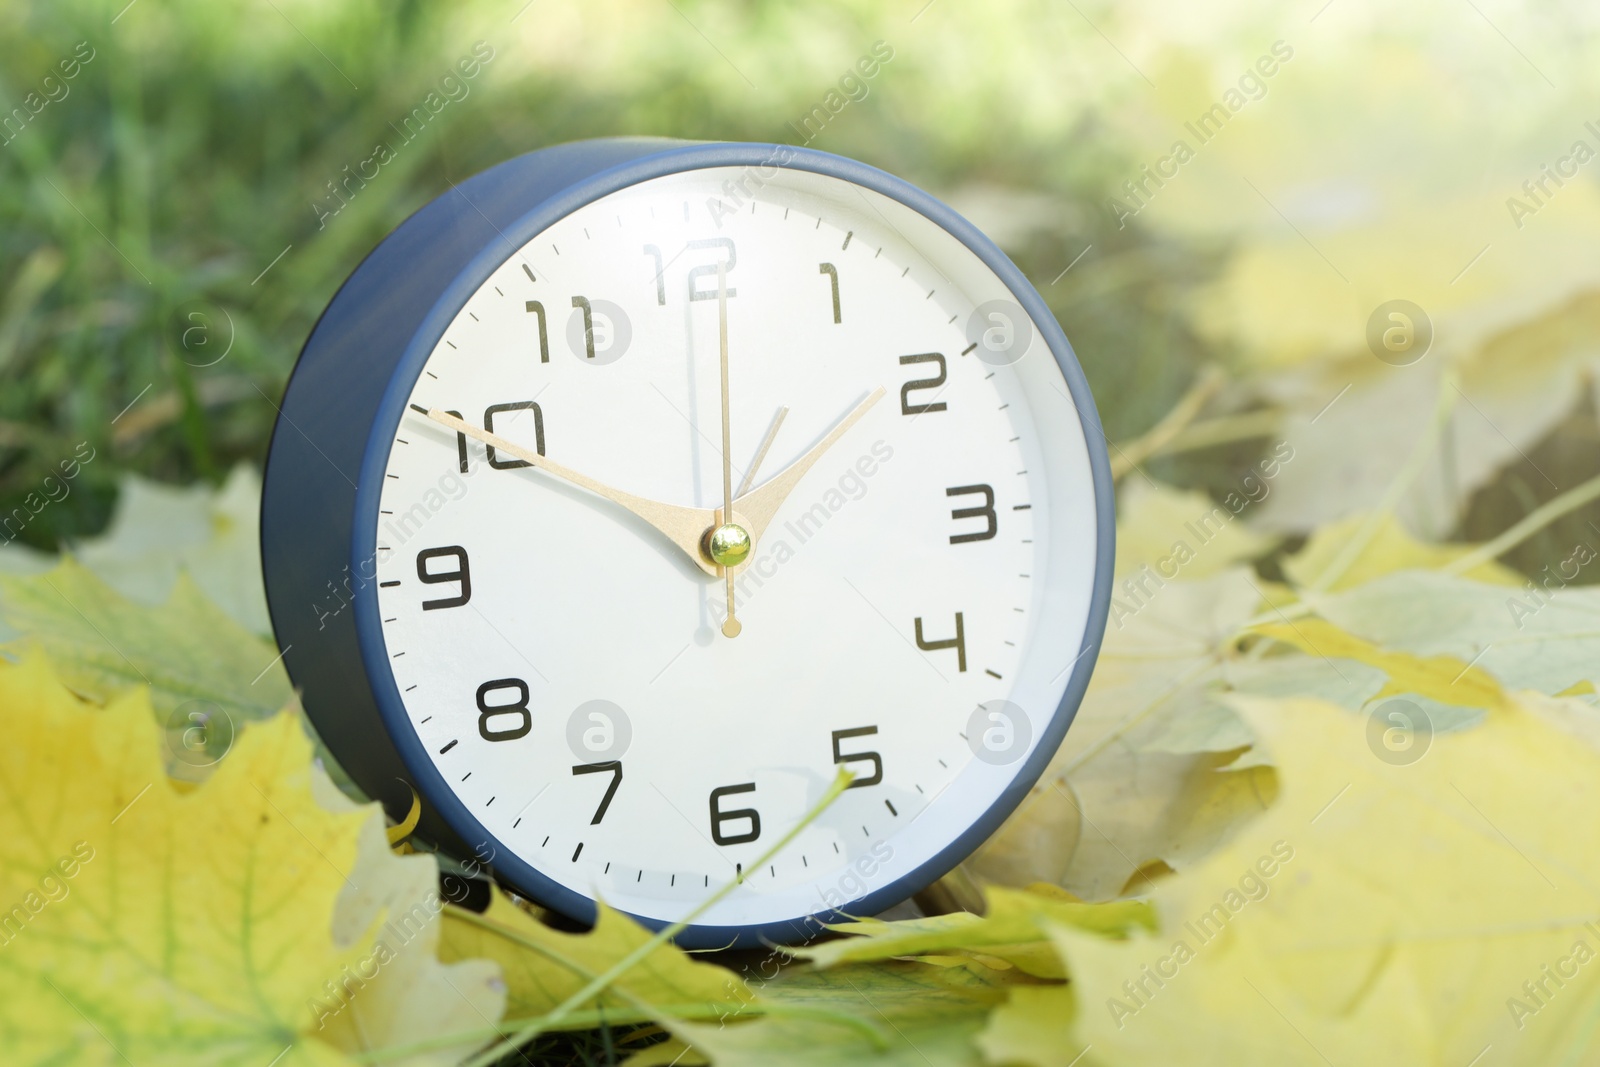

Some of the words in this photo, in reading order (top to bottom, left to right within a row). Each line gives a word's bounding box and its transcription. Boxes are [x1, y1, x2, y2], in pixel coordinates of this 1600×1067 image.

[643, 237, 737, 305] 12
[819, 262, 842, 324] 1
[525, 295, 596, 364] 11
[899, 352, 948, 416] 2
[440, 400, 546, 474] 10
[946, 483, 998, 545] 3
[416, 545, 472, 611] 9
[914, 612, 967, 672] 4
[476, 677, 532, 742] 8
[831, 725, 884, 791] 5
[572, 760, 623, 825] 7
[709, 782, 761, 846] 6
